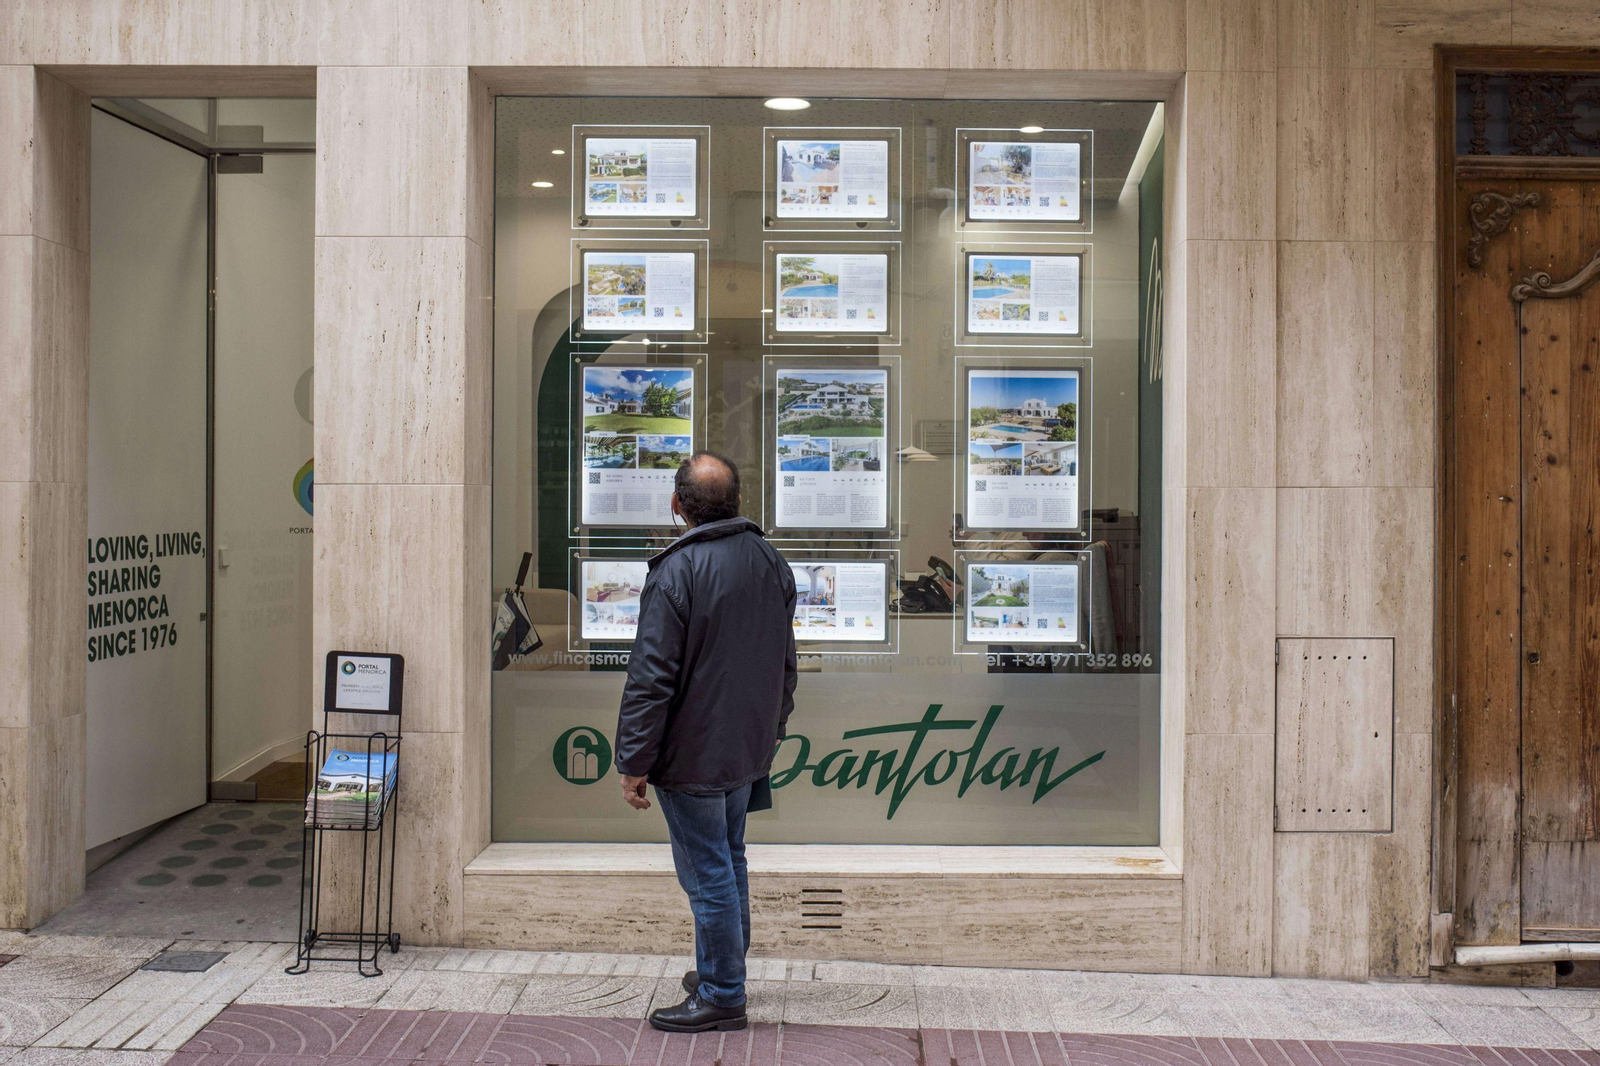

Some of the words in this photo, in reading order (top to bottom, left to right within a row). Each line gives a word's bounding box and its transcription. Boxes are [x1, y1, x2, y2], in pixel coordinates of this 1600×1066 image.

[88, 534, 154, 564] LOVING,
[156, 531, 206, 558] LIVING,
[88, 564, 161, 597] SHARING
[88, 594, 170, 630] MENORCA
[88, 630, 136, 663] SINCE
[141, 622, 178, 651] 1976
[507, 651, 629, 666] www.fincasma
[977, 652, 1006, 667] Tel.
[1012, 653, 1046, 667] +34
[1051, 653, 1079, 667] 971
[1086, 653, 1117, 668] 352
[1121, 653, 1153, 668] 896
